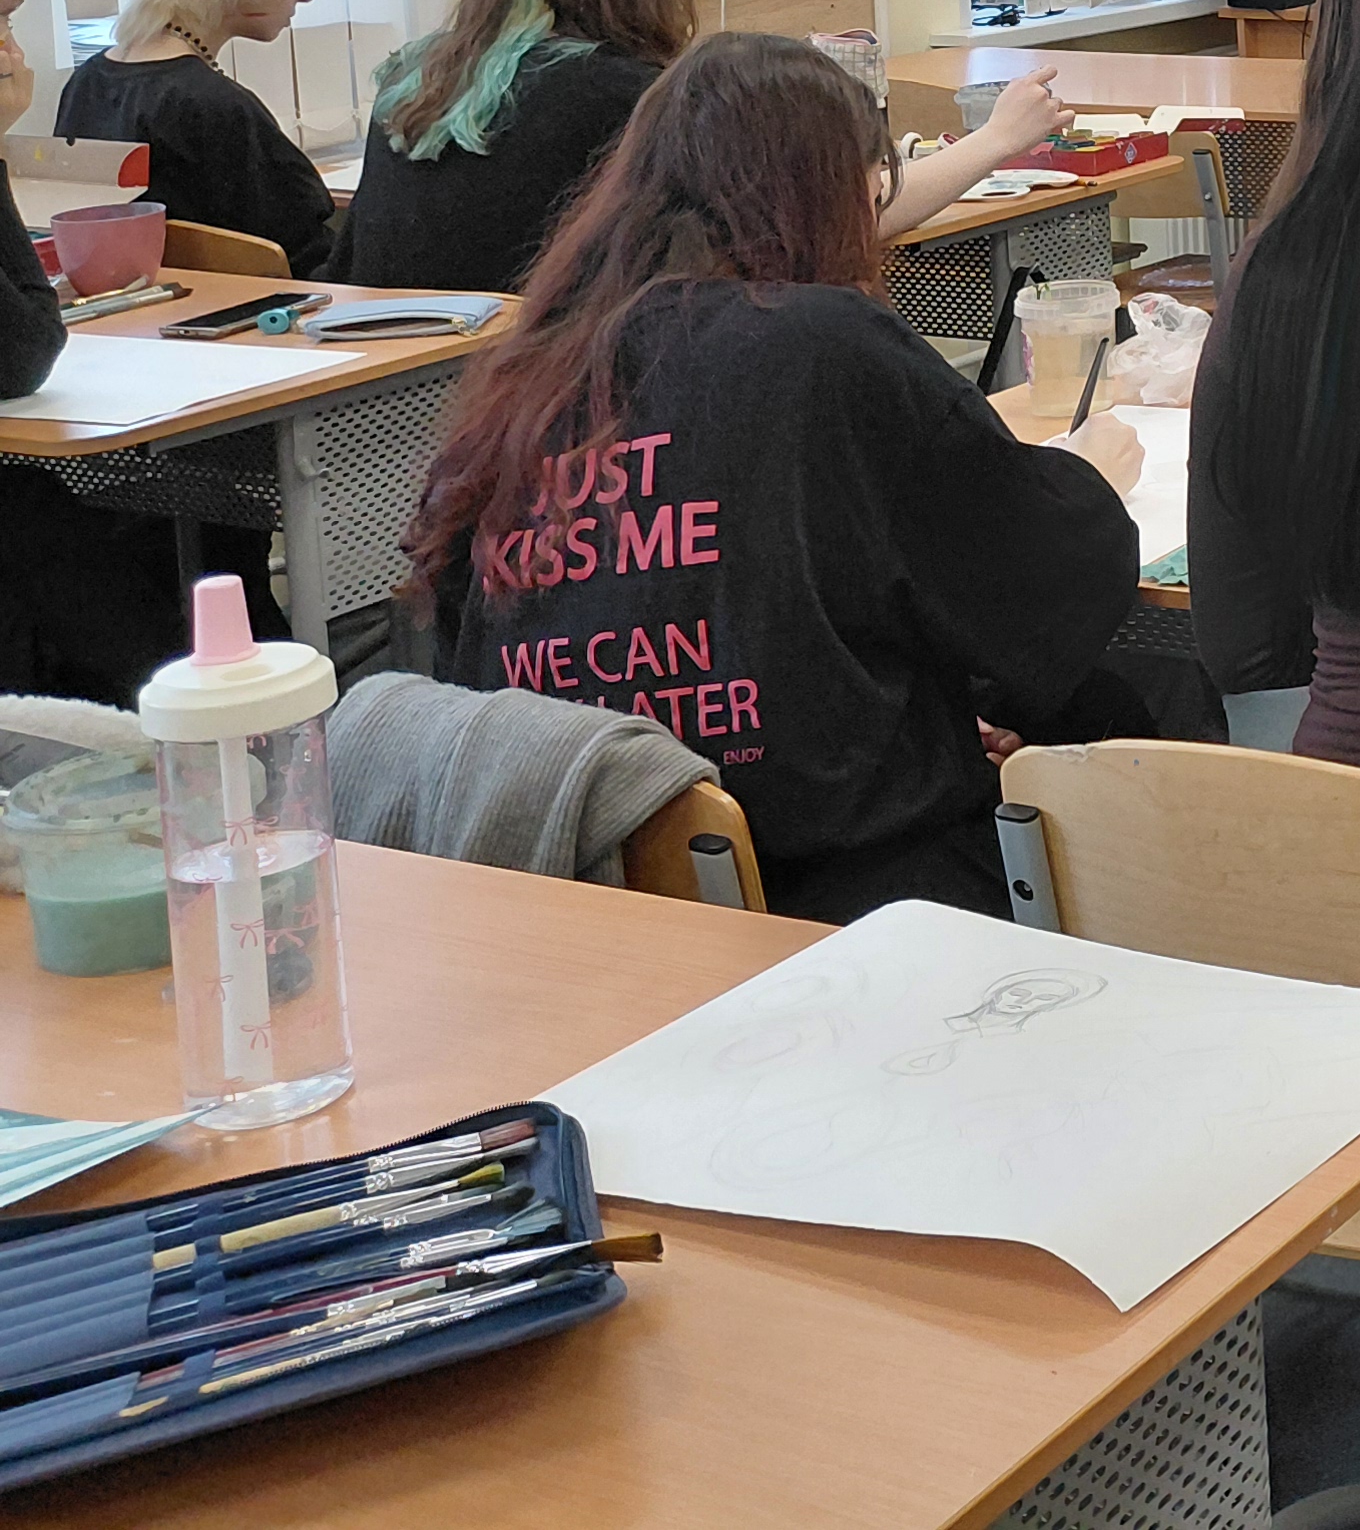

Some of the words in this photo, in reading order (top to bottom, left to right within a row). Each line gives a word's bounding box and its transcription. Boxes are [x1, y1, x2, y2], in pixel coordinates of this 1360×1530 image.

[530, 432, 672, 516] JUST
[482, 516, 598, 592] KISS
[615, 500, 720, 575] ME
[501, 636, 579, 692] WE
[586, 618, 711, 683] CAN
[597, 678, 762, 741] TER
[722, 745, 765, 765] ENJOY
